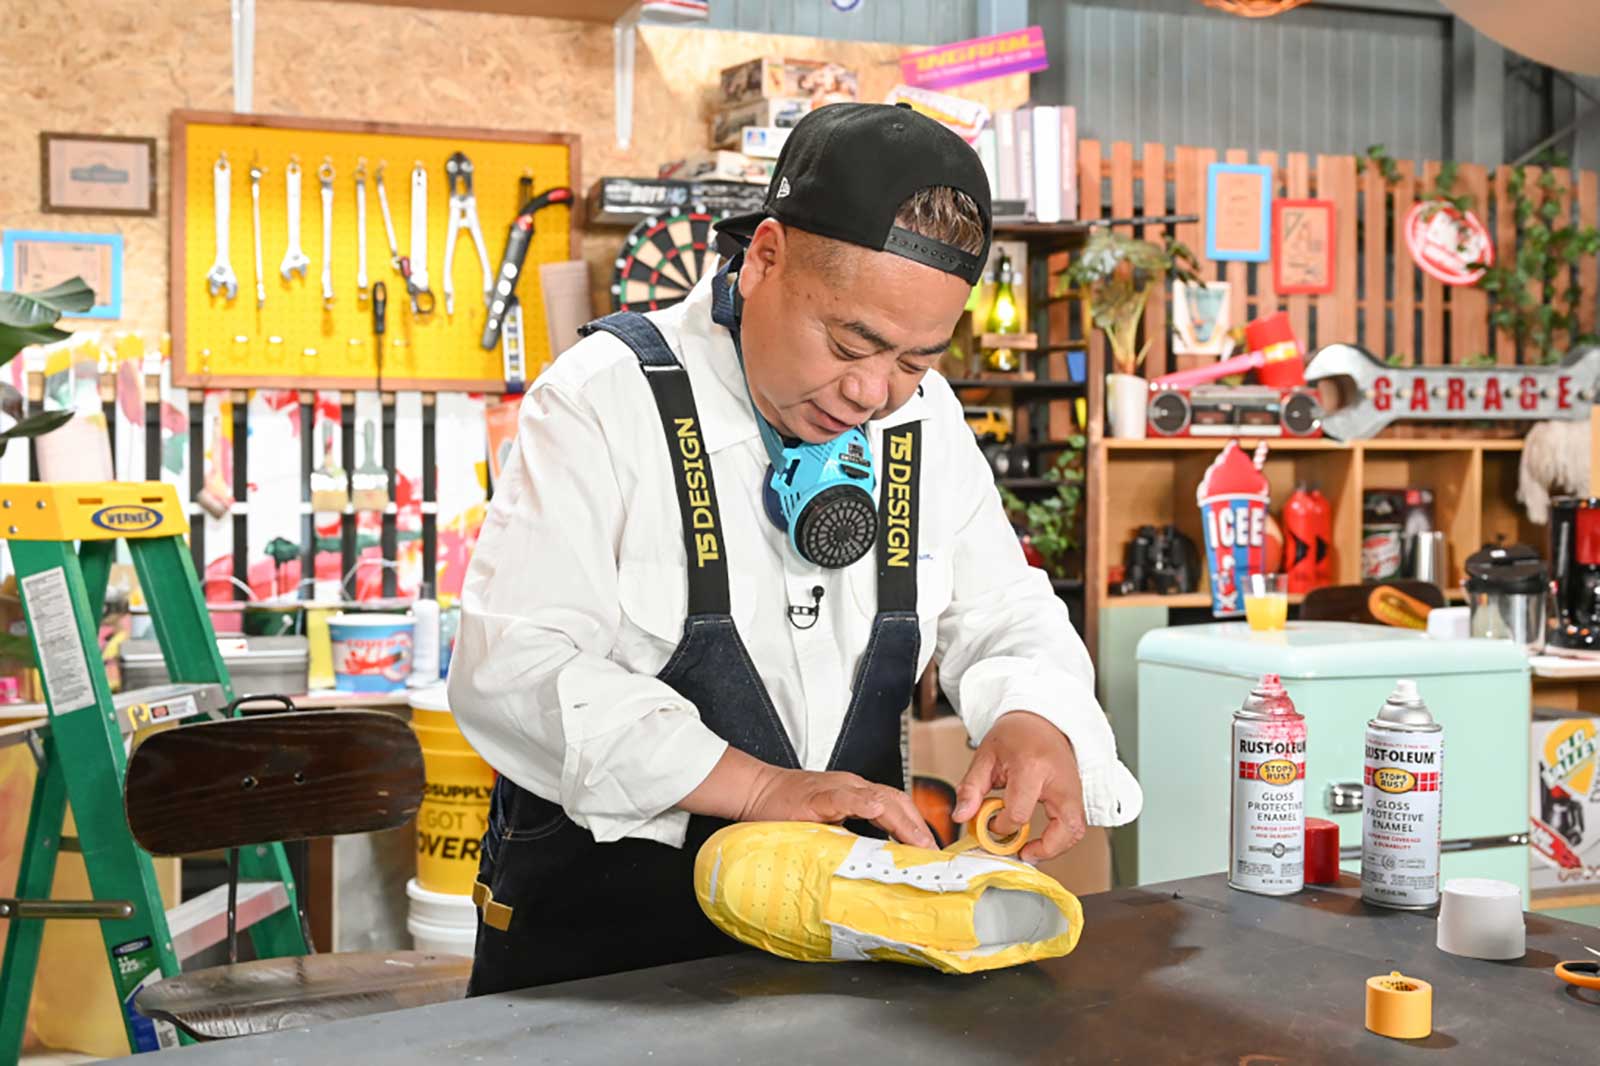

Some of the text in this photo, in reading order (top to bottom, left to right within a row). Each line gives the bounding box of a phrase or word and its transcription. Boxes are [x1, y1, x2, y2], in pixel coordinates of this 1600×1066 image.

[1374, 376, 1573, 412] GARAGE
[674, 417, 719, 568] TS DESIGN
[887, 431, 913, 567] TS DESIGN
[1208, 506, 1265, 550] ICEE
[1239, 738, 1306, 754] RUST-OLEU
[1264, 764, 1294, 773] STOPS
[1379, 771, 1408, 781] STOPS
[1380, 779, 1404, 788] RUST
[1262, 792, 1295, 801] GLOSS
[1376, 800, 1411, 811] GLOSS
[425, 809, 467, 831] GOT
[1257, 813, 1297, 822] ENAMEL
[1372, 820, 1414, 833] ENAMEL
